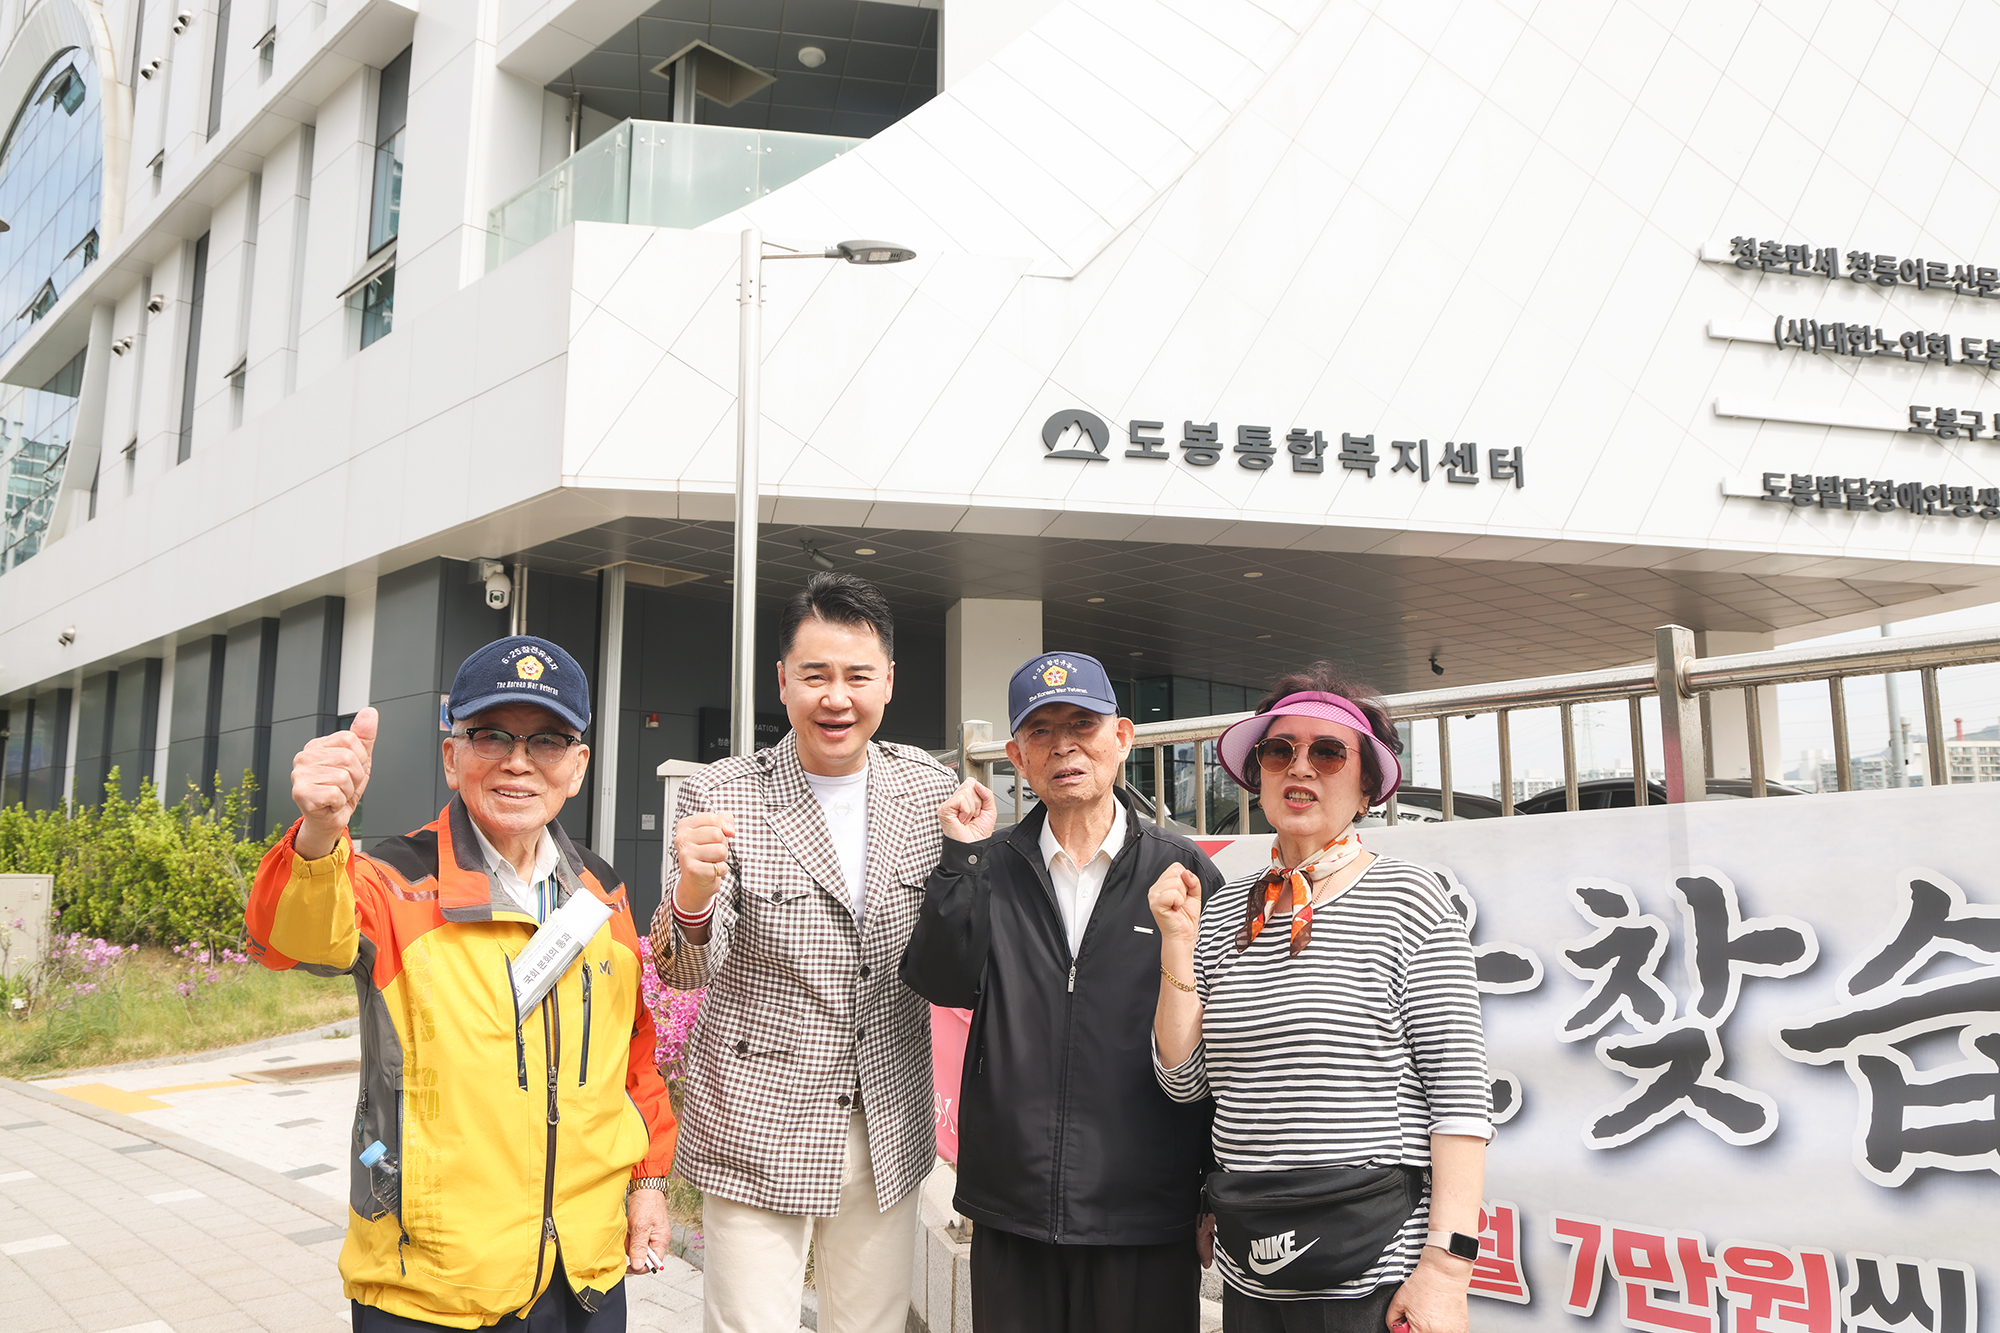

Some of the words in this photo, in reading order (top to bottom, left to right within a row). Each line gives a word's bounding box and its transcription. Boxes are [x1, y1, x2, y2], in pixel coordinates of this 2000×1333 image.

[1730, 236, 1840, 280] 청춘만세
[1774, 314, 1953, 366] (사)대한노인회
[1908, 405, 1986, 441] 도봉구
[1125, 419, 1525, 488] 도봉통합복지센터
[1761, 472, 2000, 520] 도봉발달장애인평생
[496, 681, 506, 689] The
[527, 681, 538, 690] War
[1250, 1230, 1297, 1260] NIKE
